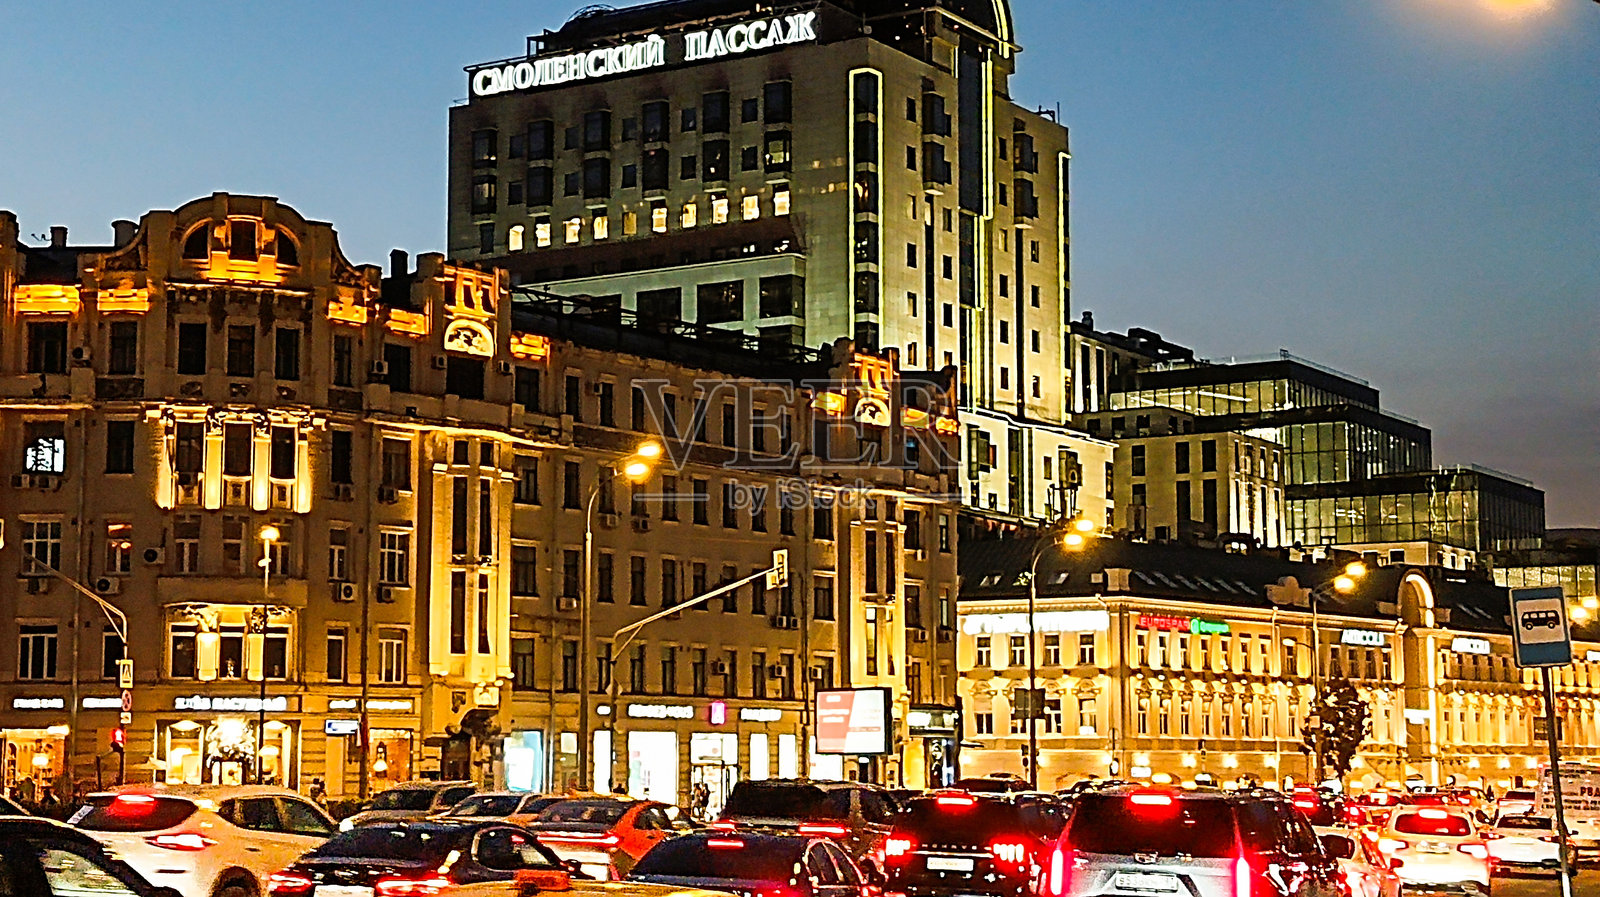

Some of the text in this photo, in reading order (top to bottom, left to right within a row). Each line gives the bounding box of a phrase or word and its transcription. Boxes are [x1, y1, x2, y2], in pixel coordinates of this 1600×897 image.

[473, 11, 816, 96] СМОЛЕНСКИЙ ПАССАЖ
[1140, 616, 1190, 630] EUROSPAR
